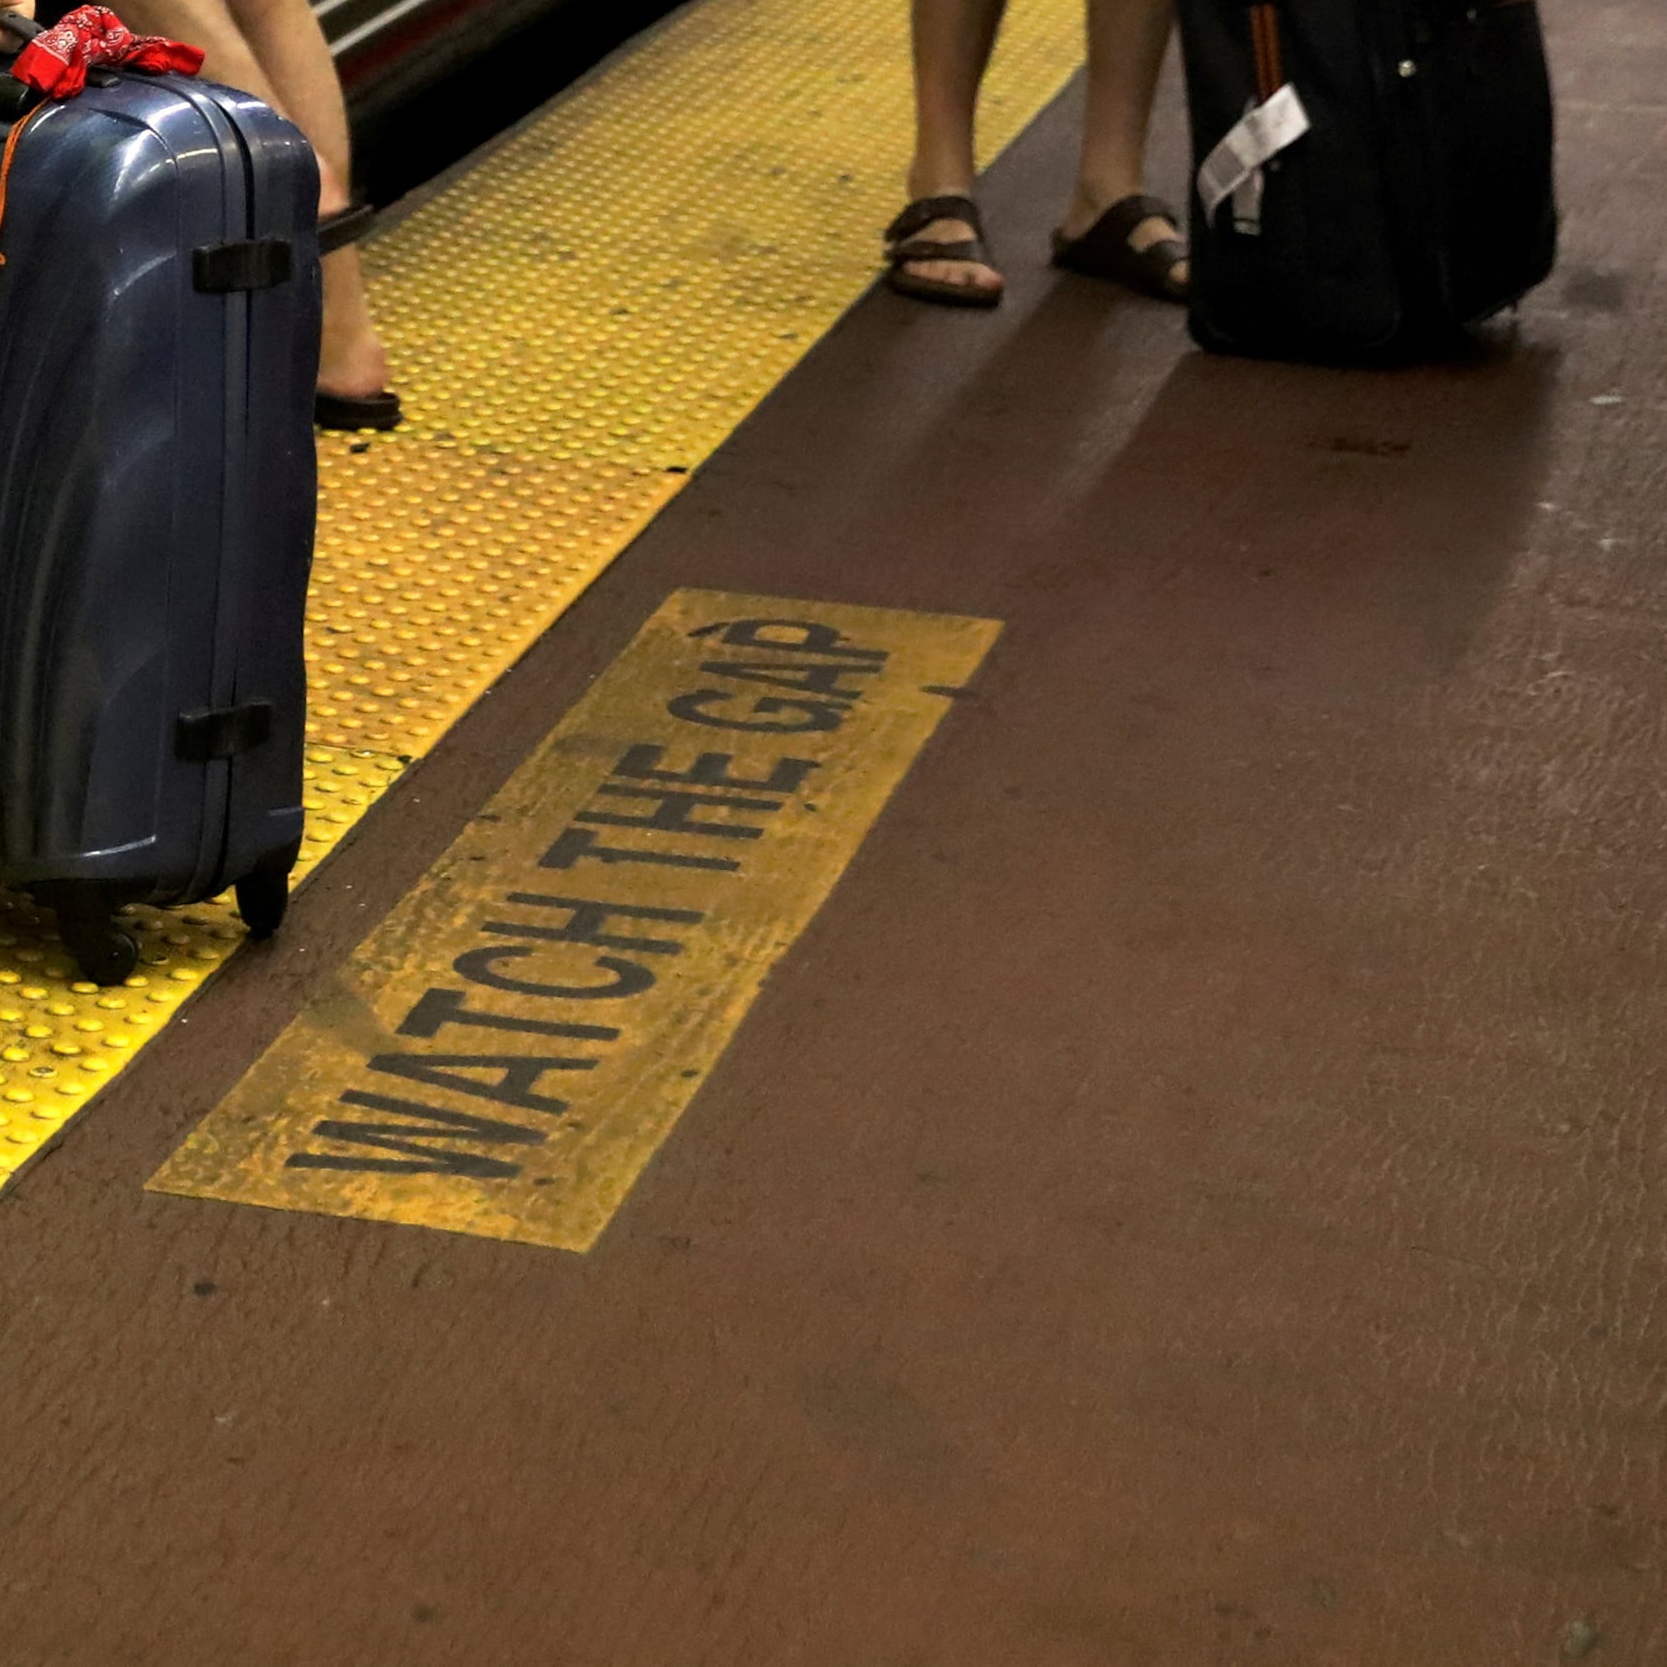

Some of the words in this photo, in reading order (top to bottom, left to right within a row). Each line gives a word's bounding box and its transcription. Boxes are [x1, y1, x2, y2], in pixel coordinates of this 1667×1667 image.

[666, 616, 891, 735] GAP
[539, 743, 823, 872] THE
[285, 890, 703, 1180] WATCH
